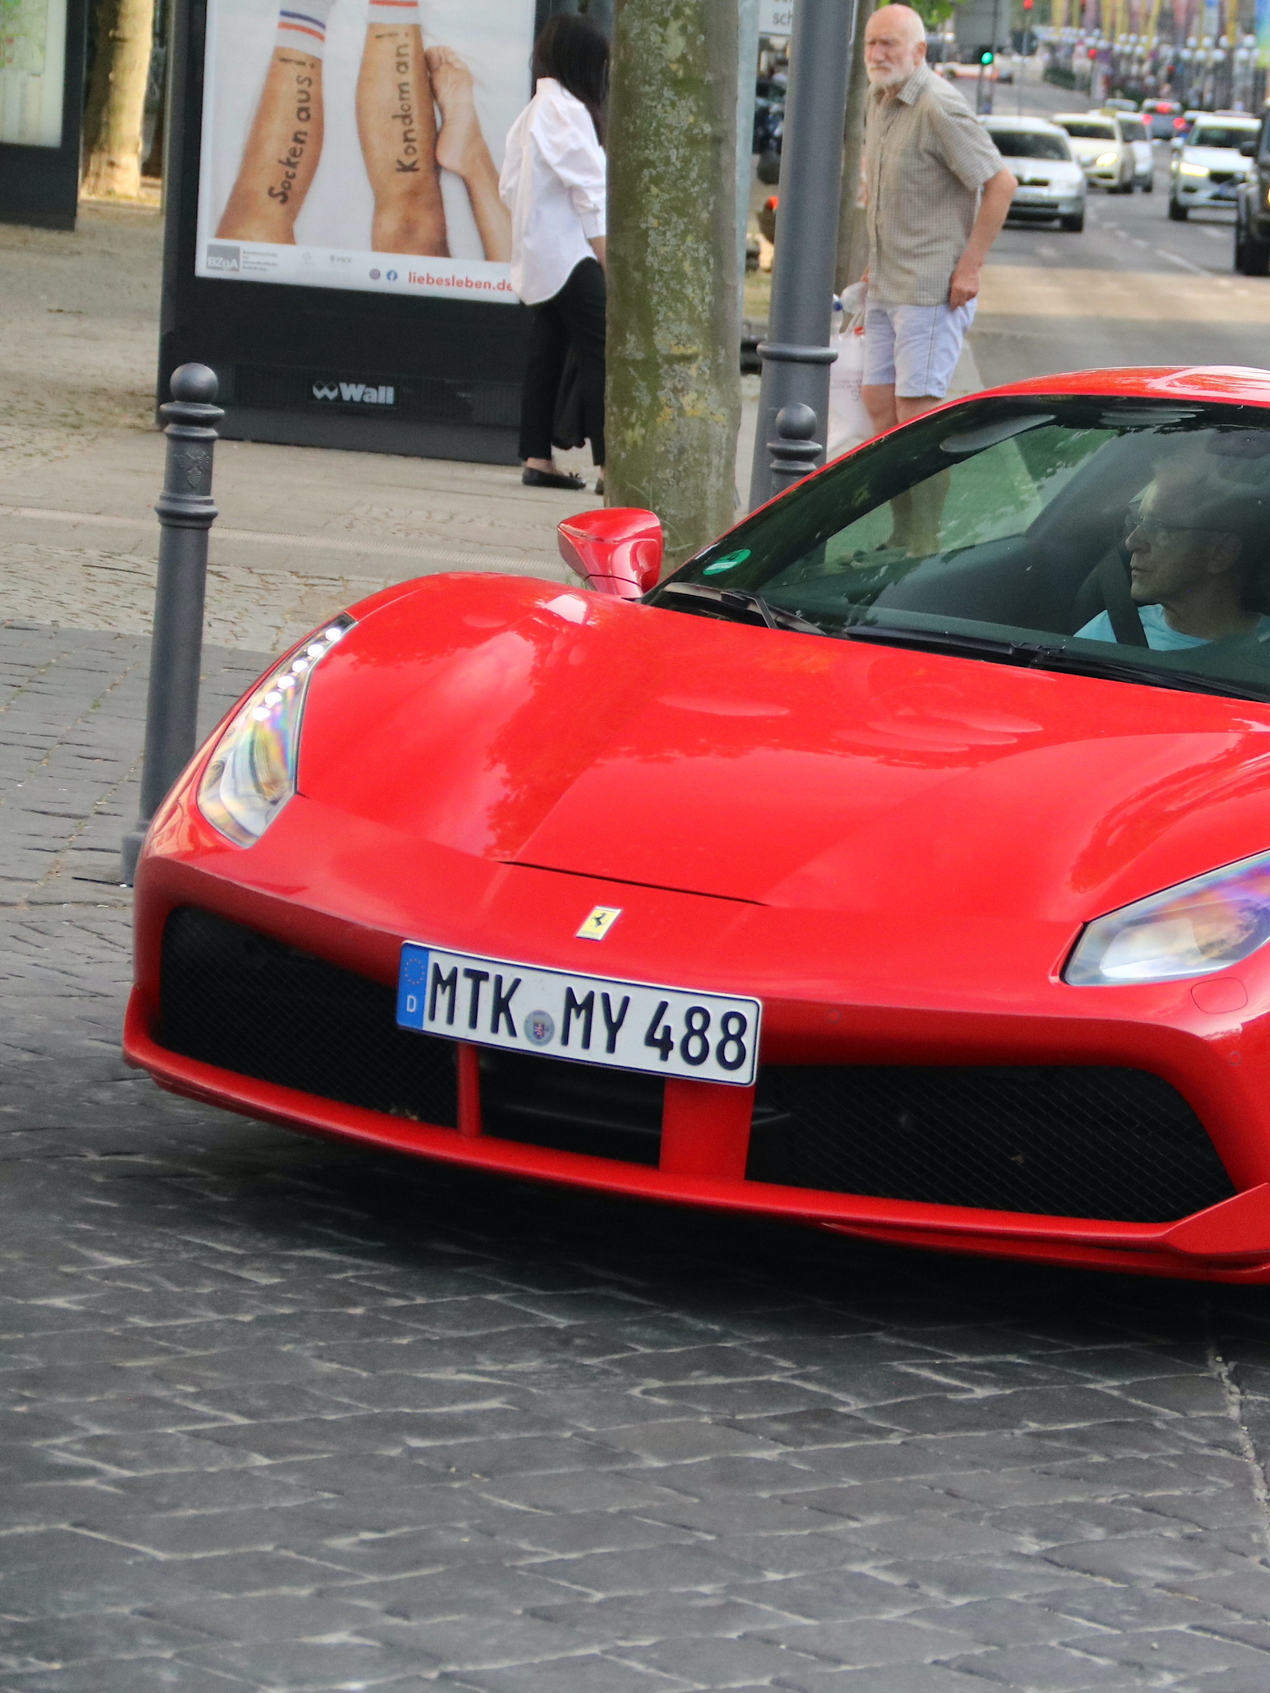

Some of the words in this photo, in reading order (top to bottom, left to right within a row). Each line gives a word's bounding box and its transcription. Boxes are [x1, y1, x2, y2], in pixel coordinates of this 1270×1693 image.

[391, 81, 420, 173] Kondom
[267, 130, 308, 204] Socken
[207, 257, 239, 272] BZgA
[408, 271, 513, 292] liebesleben.de
[338, 382, 395, 405] Wall
[406, 994, 417, 1013] D
[428, 962, 522, 1038] MTK
[560, 986, 631, 1054] MY
[644, 1000, 748, 1071] 488
